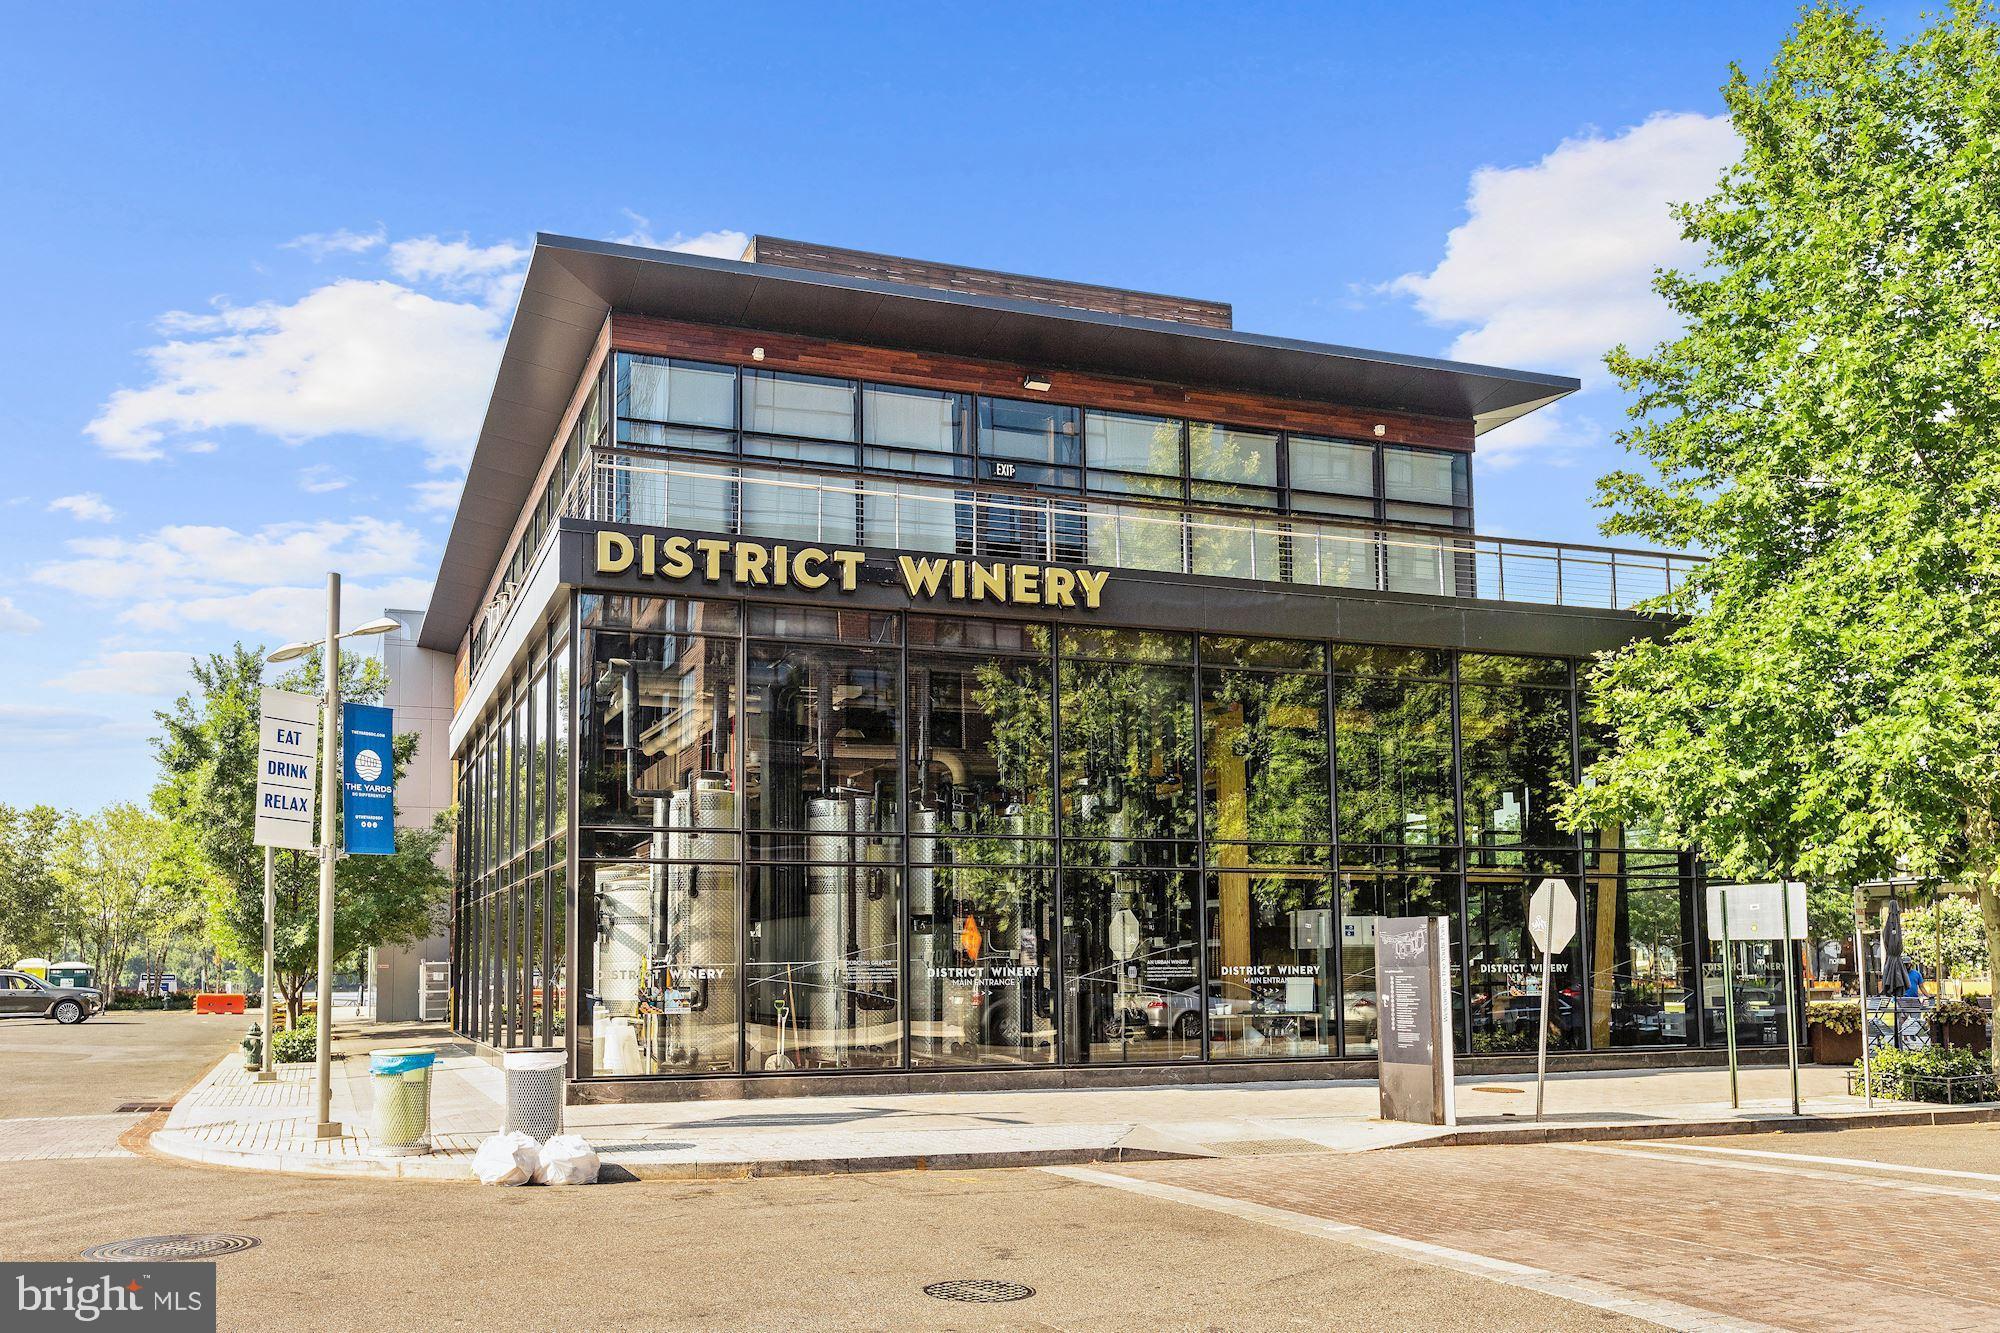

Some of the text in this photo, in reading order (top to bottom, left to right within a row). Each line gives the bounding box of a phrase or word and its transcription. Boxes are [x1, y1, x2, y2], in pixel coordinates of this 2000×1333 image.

[996, 463, 1014, 477] EXIT
[597, 530, 1111, 609] DISTRICT WINERY
[277, 728, 302, 746] EAT
[267, 760, 308, 780] DRINK
[345, 782, 393, 794] THE YARDS
[264, 793, 308, 813] RELAX
[670, 968, 726, 979] WINERY
[928, 966, 1040, 978] DISTRICT WINERY
[1221, 965, 1321, 976] DISTRICT WINERY
[1480, 963, 1569, 973] DISTRICT WIERY
[974, 978, 1016, 986] ENTRANCE
[1243, 976, 1289, 985] MAIN ENTRAN
[1441, 989, 1449, 1023] Welcome
